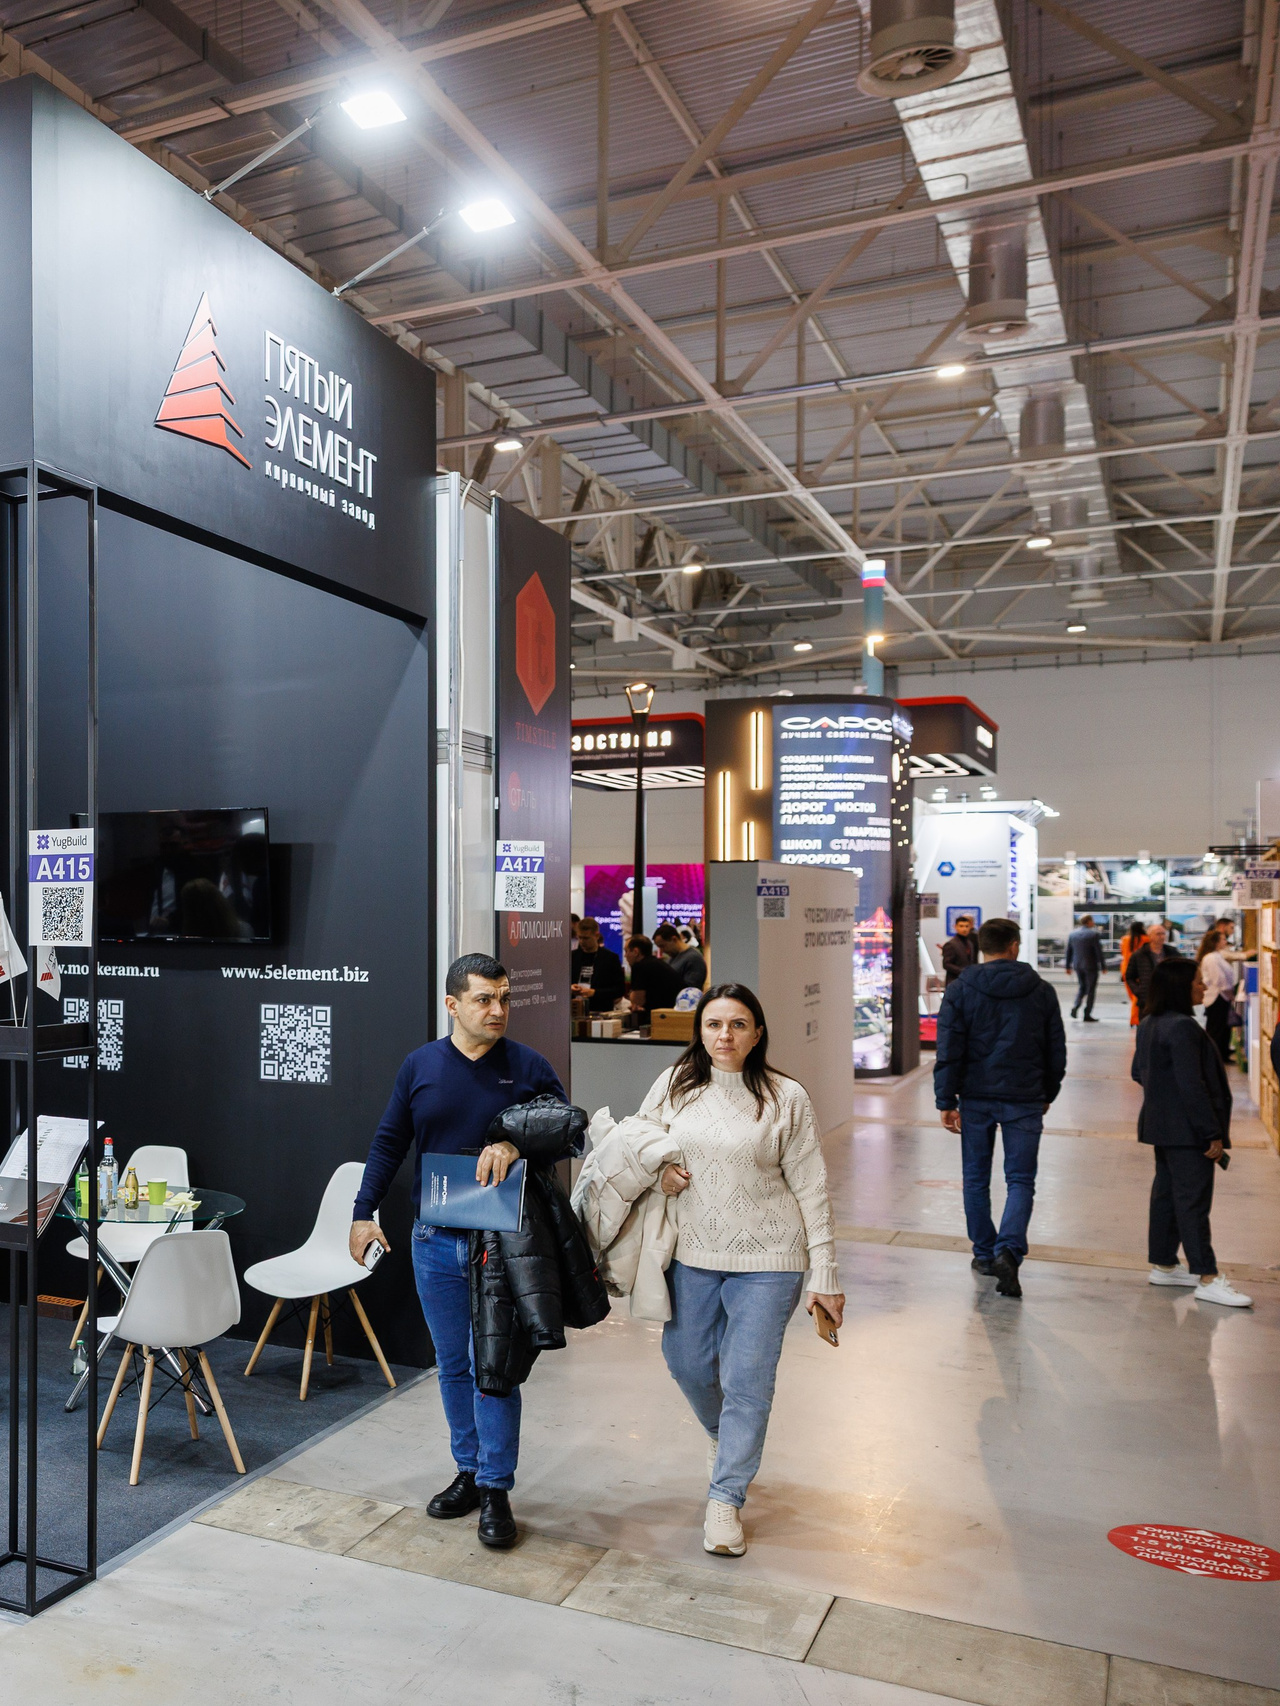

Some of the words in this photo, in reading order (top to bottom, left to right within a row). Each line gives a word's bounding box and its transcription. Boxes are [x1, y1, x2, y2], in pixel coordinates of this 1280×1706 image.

[264, 330, 353, 430] ПЯТЫЙ
[265, 395, 378, 499] ЭЛЕМЕНТ
[265, 460, 336, 508] кирпичный
[341, 499, 376, 531] завод
[780, 802, 828, 814] ДОРОГ
[780, 814, 836, 825] ПАРКОВ
[51, 835, 87, 849] YugBuild
[513, 845, 540, 853] YugBuild
[780, 839, 822, 850] ШКОЛ
[501, 857, 542, 872] A417
[780, 853, 851, 865] КУРОРТОВ
[36, 857, 90, 880] A415
[761, 886, 788, 896] A419
[510, 920, 563, 941] АЛЮМОЦИНК
[59, 961, 160, 978] w.mokeram.ru
[220, 964, 370, 983] www.5element.biz
